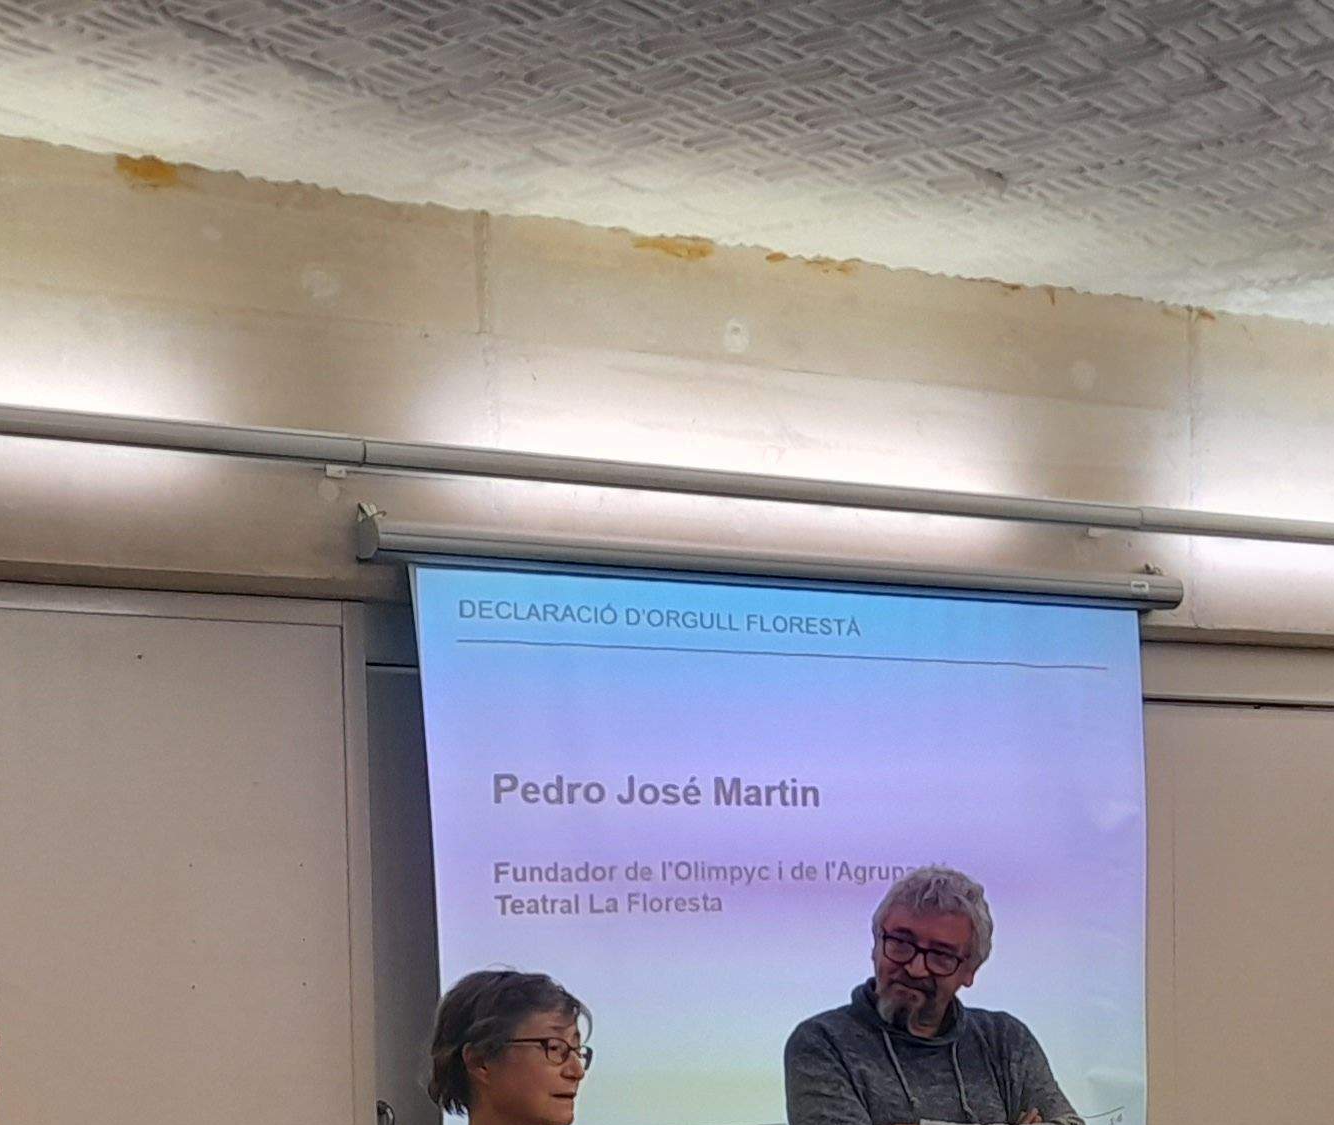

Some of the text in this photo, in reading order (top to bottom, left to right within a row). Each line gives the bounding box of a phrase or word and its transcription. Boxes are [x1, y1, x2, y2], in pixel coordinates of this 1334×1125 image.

[458, 599, 861, 637] DECLARACIÓ D'ORGULL FLORESTÀ
[493, 772, 820, 808] Pedro José Martin
[493, 860, 948, 886] Fundador de l'Olimpyc i de l'Agrup
[494, 892, 723, 916] Teatral La Floresta
